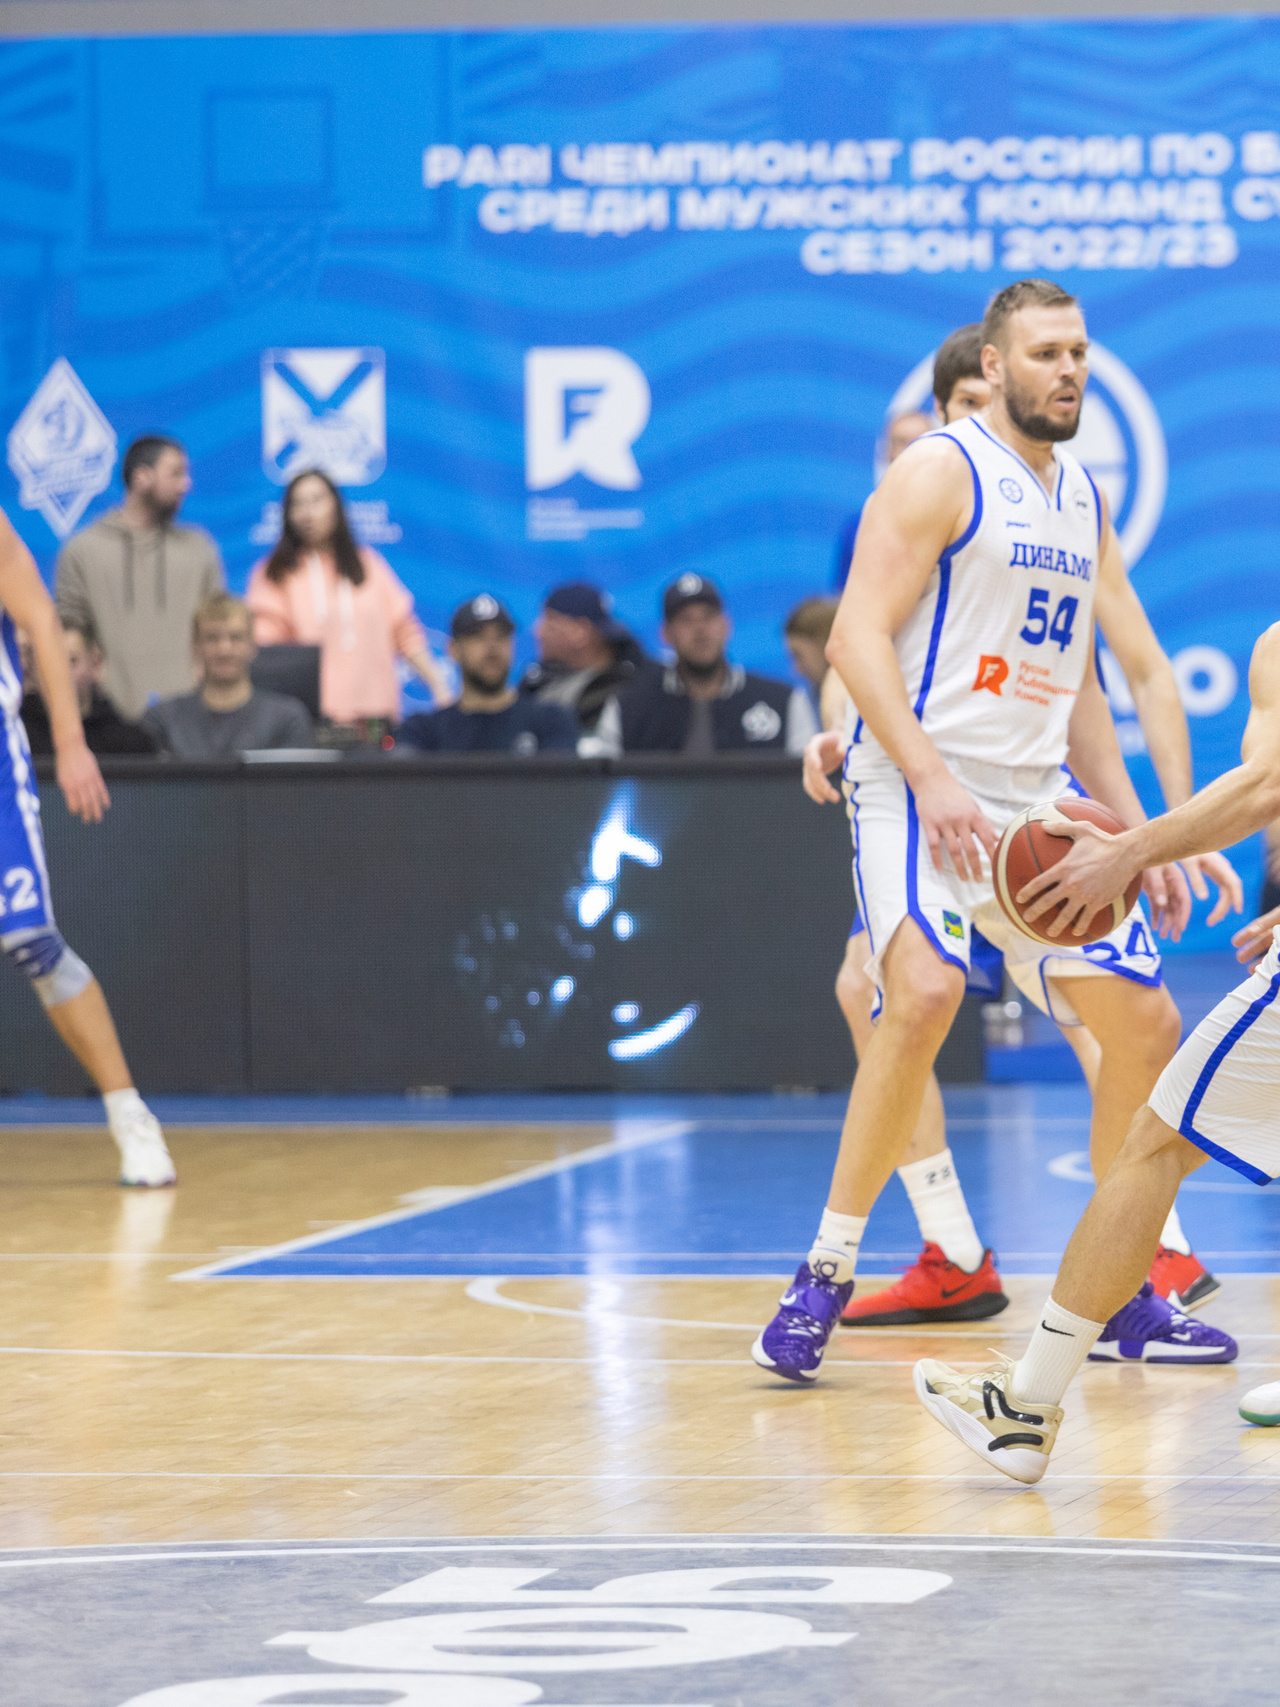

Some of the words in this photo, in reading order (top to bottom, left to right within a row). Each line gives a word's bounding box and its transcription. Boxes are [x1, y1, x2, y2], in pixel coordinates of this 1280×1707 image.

[560, 140, 900, 186] ЧЕМПИОНАТ
[908, 136, 1143, 184] РОССИИ
[1149, 131, 1235, 177] ПО
[477, 188, 669, 237] СРЕДИ
[676, 183, 968, 231] МУЖСКИХ
[976, 178, 1226, 227] КОМАНД
[800, 228, 994, 275] СЕЗОН
[1001, 223, 1239, 272] 2022/23
[1020, 586, 1080, 653] 54
